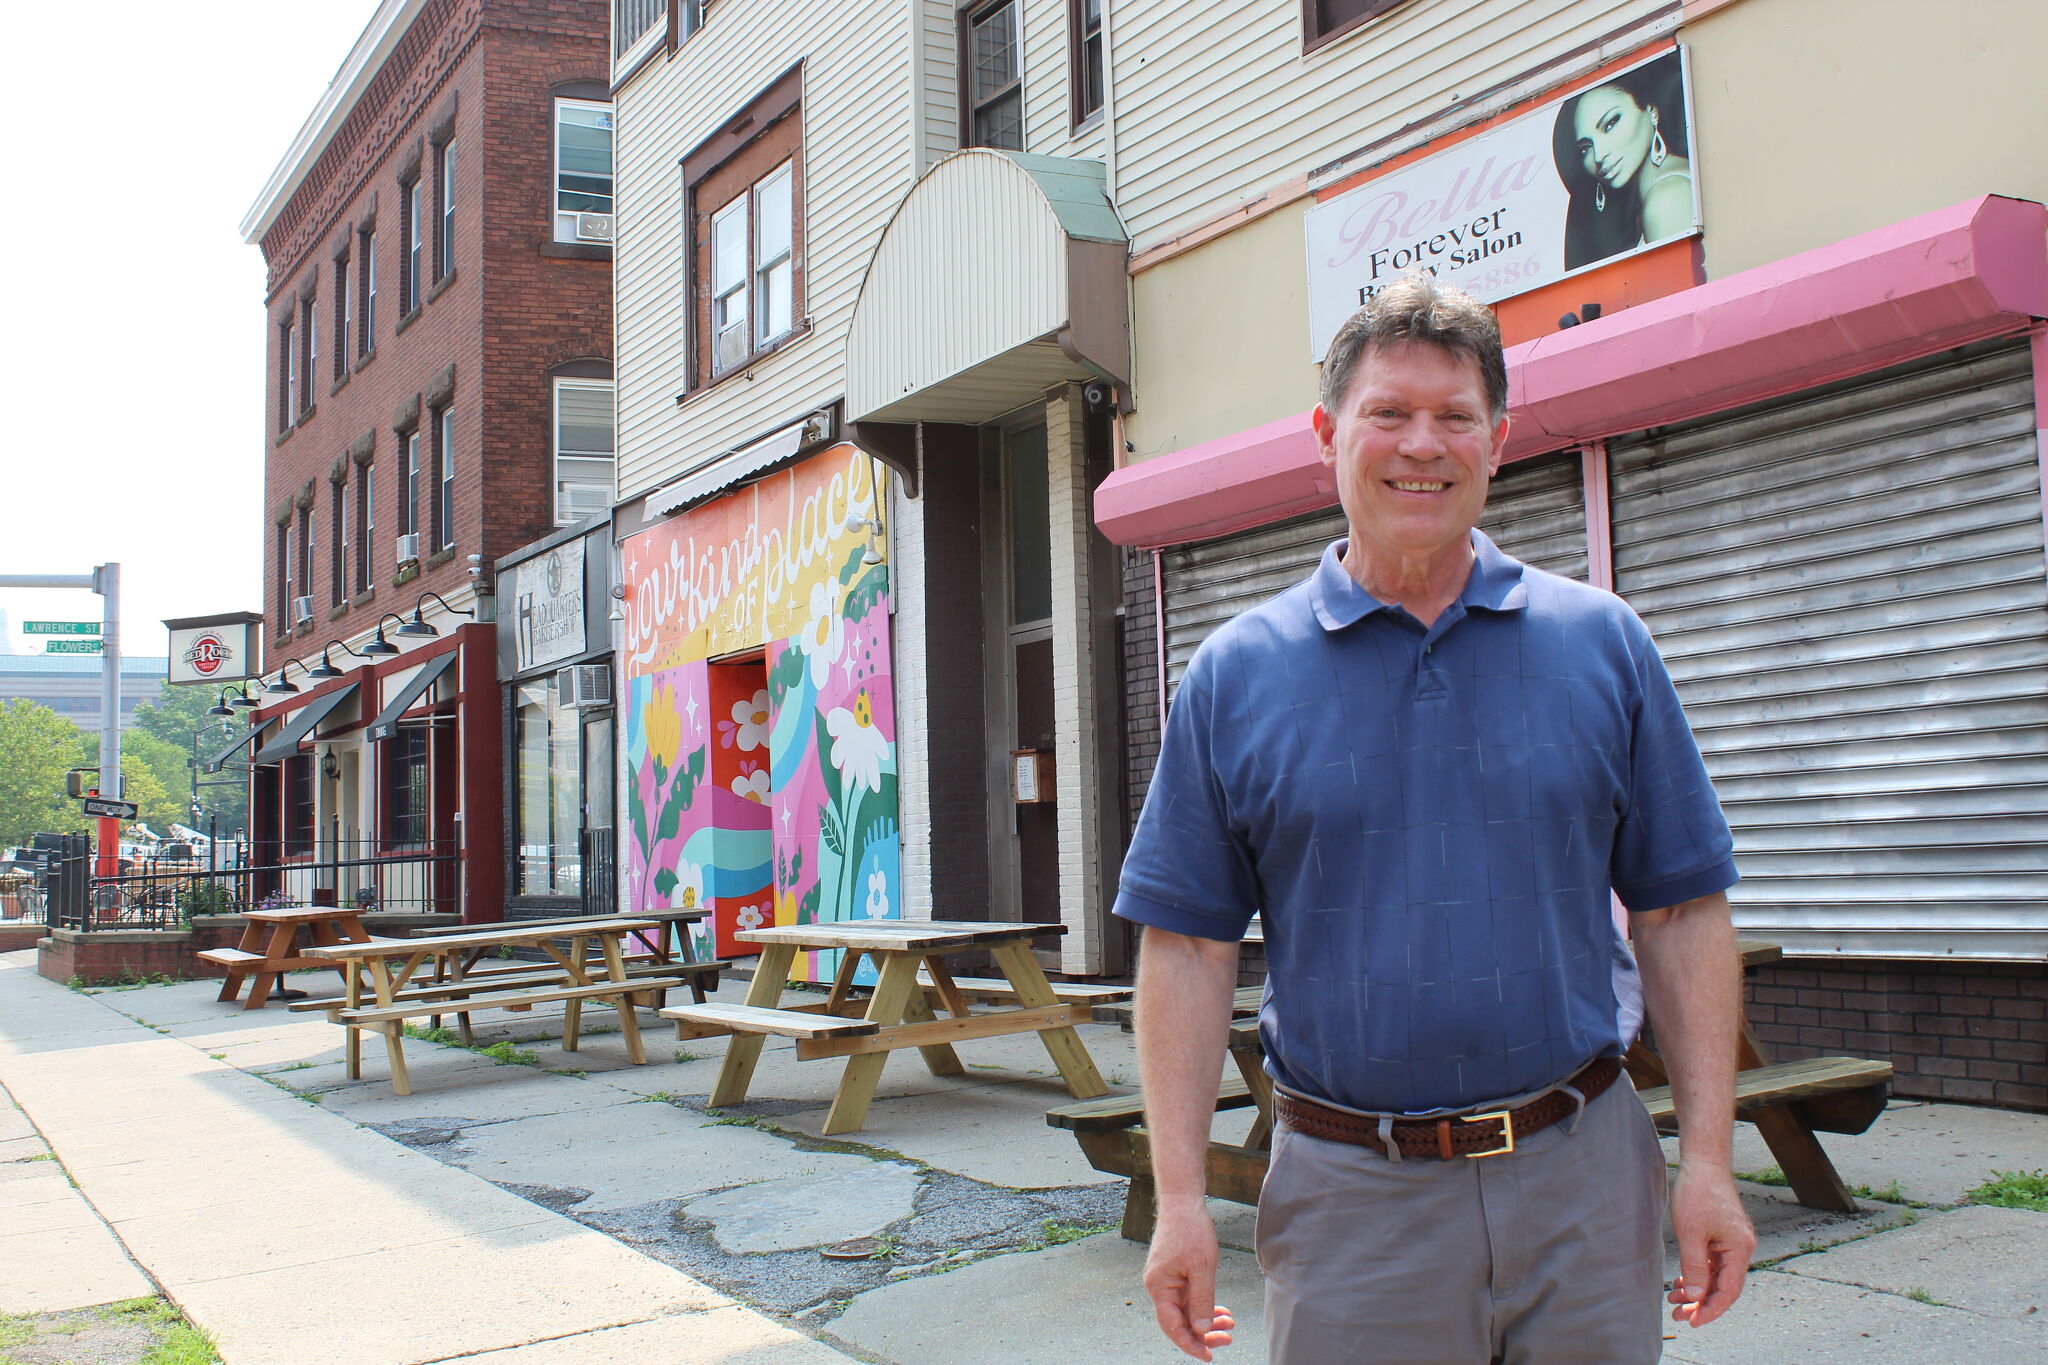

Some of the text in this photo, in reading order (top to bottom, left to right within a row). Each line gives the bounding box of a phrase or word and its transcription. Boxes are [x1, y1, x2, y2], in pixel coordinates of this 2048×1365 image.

[1326, 153, 1546, 268] Bella
[1368, 207, 1506, 281] Forever
[1449, 230, 1523, 271] Salon
[762, 449, 882, 643] place
[625, 482, 763, 680] your kind
[24, 623, 77, 633] LAWRENCE
[48, 642, 92, 652] FLOWER
[89, 803, 104, 812] ONE
